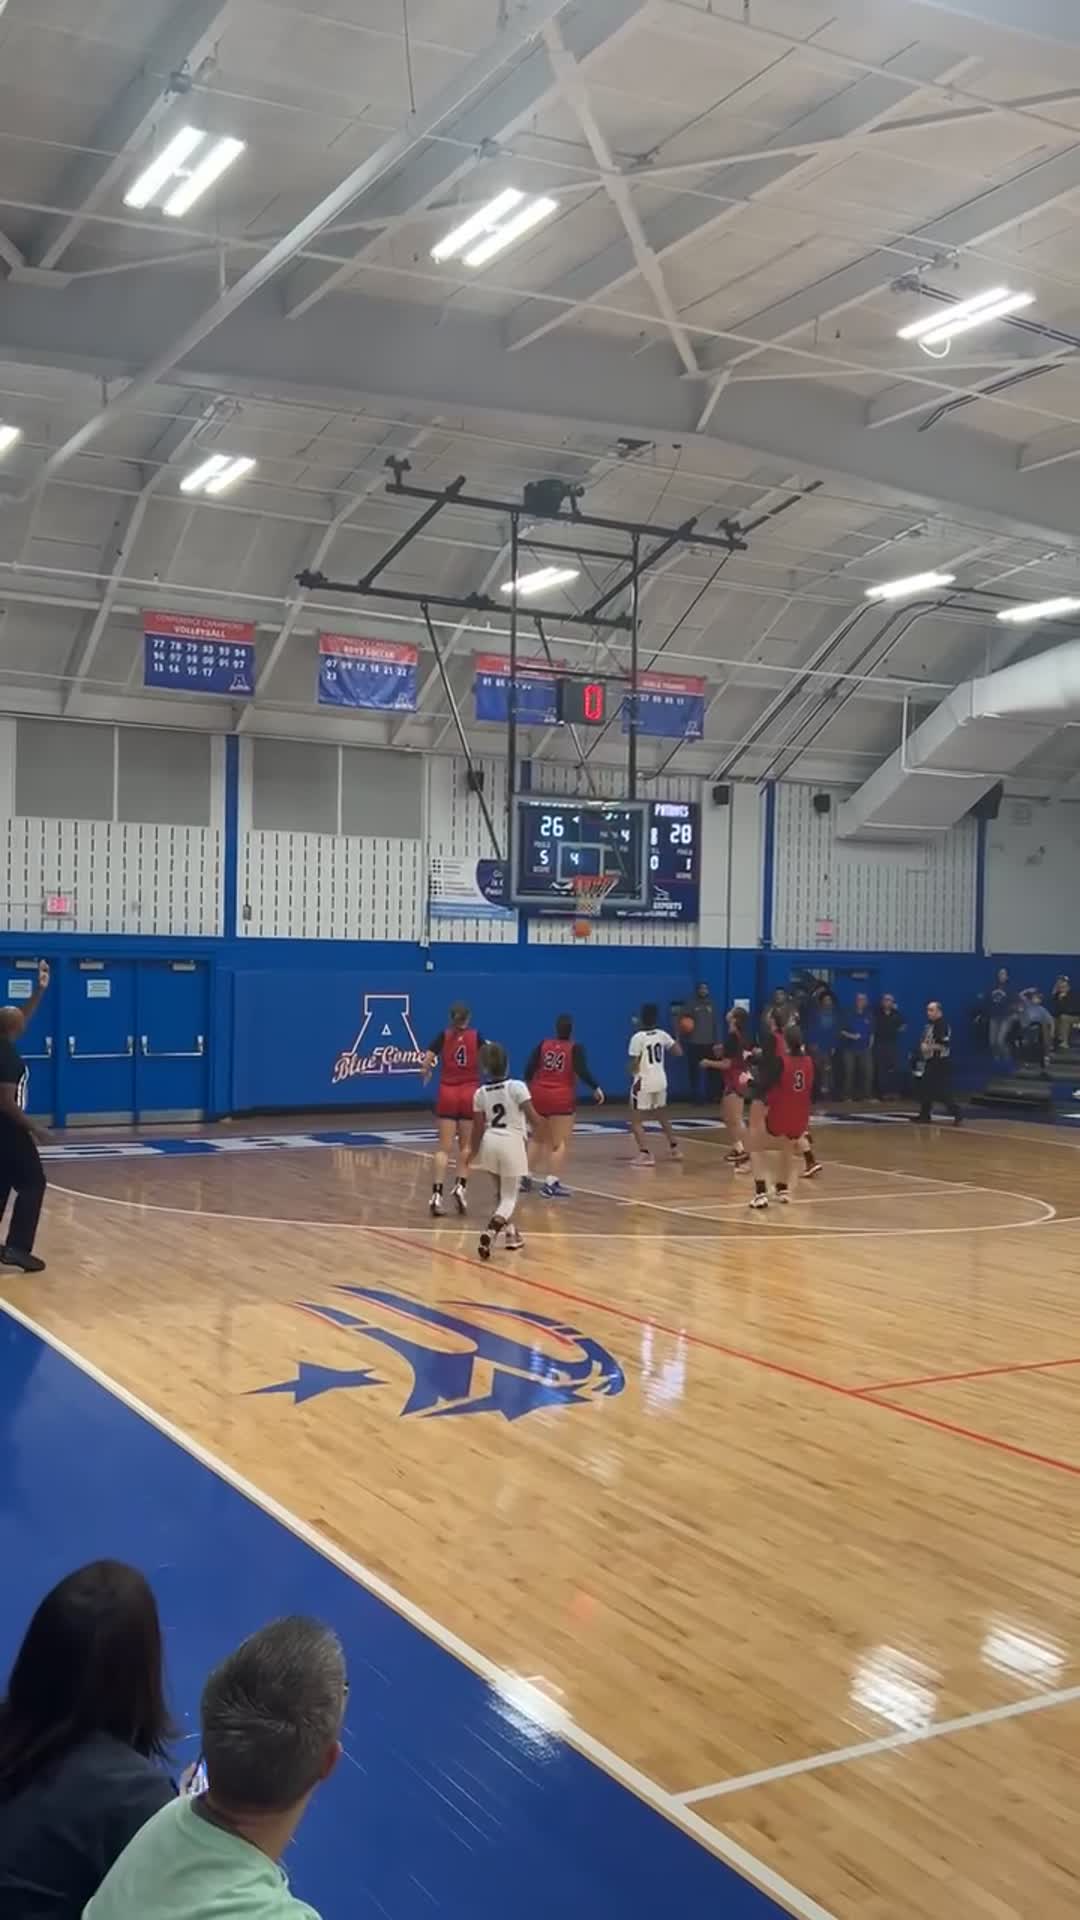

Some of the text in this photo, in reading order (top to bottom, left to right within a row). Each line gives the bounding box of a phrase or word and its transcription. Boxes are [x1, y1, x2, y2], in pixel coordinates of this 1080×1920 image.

[583, 683, 604, 720] 0
[540, 815, 565, 837] 26
[670, 824, 692, 844] 28
[539, 849, 550, 865] 5
[569, 852, 579, 865] 4
[649, 855, 659, 870] 0
[332, 1045, 439, 1084] Blue Comes
[454, 1045, 468, 1067] 4
[544, 1050, 566, 1073] 24
[646, 1042, 663, 1066] 10
[792, 1071, 805, 1092] 3
[490, 1102, 507, 1129] 2
